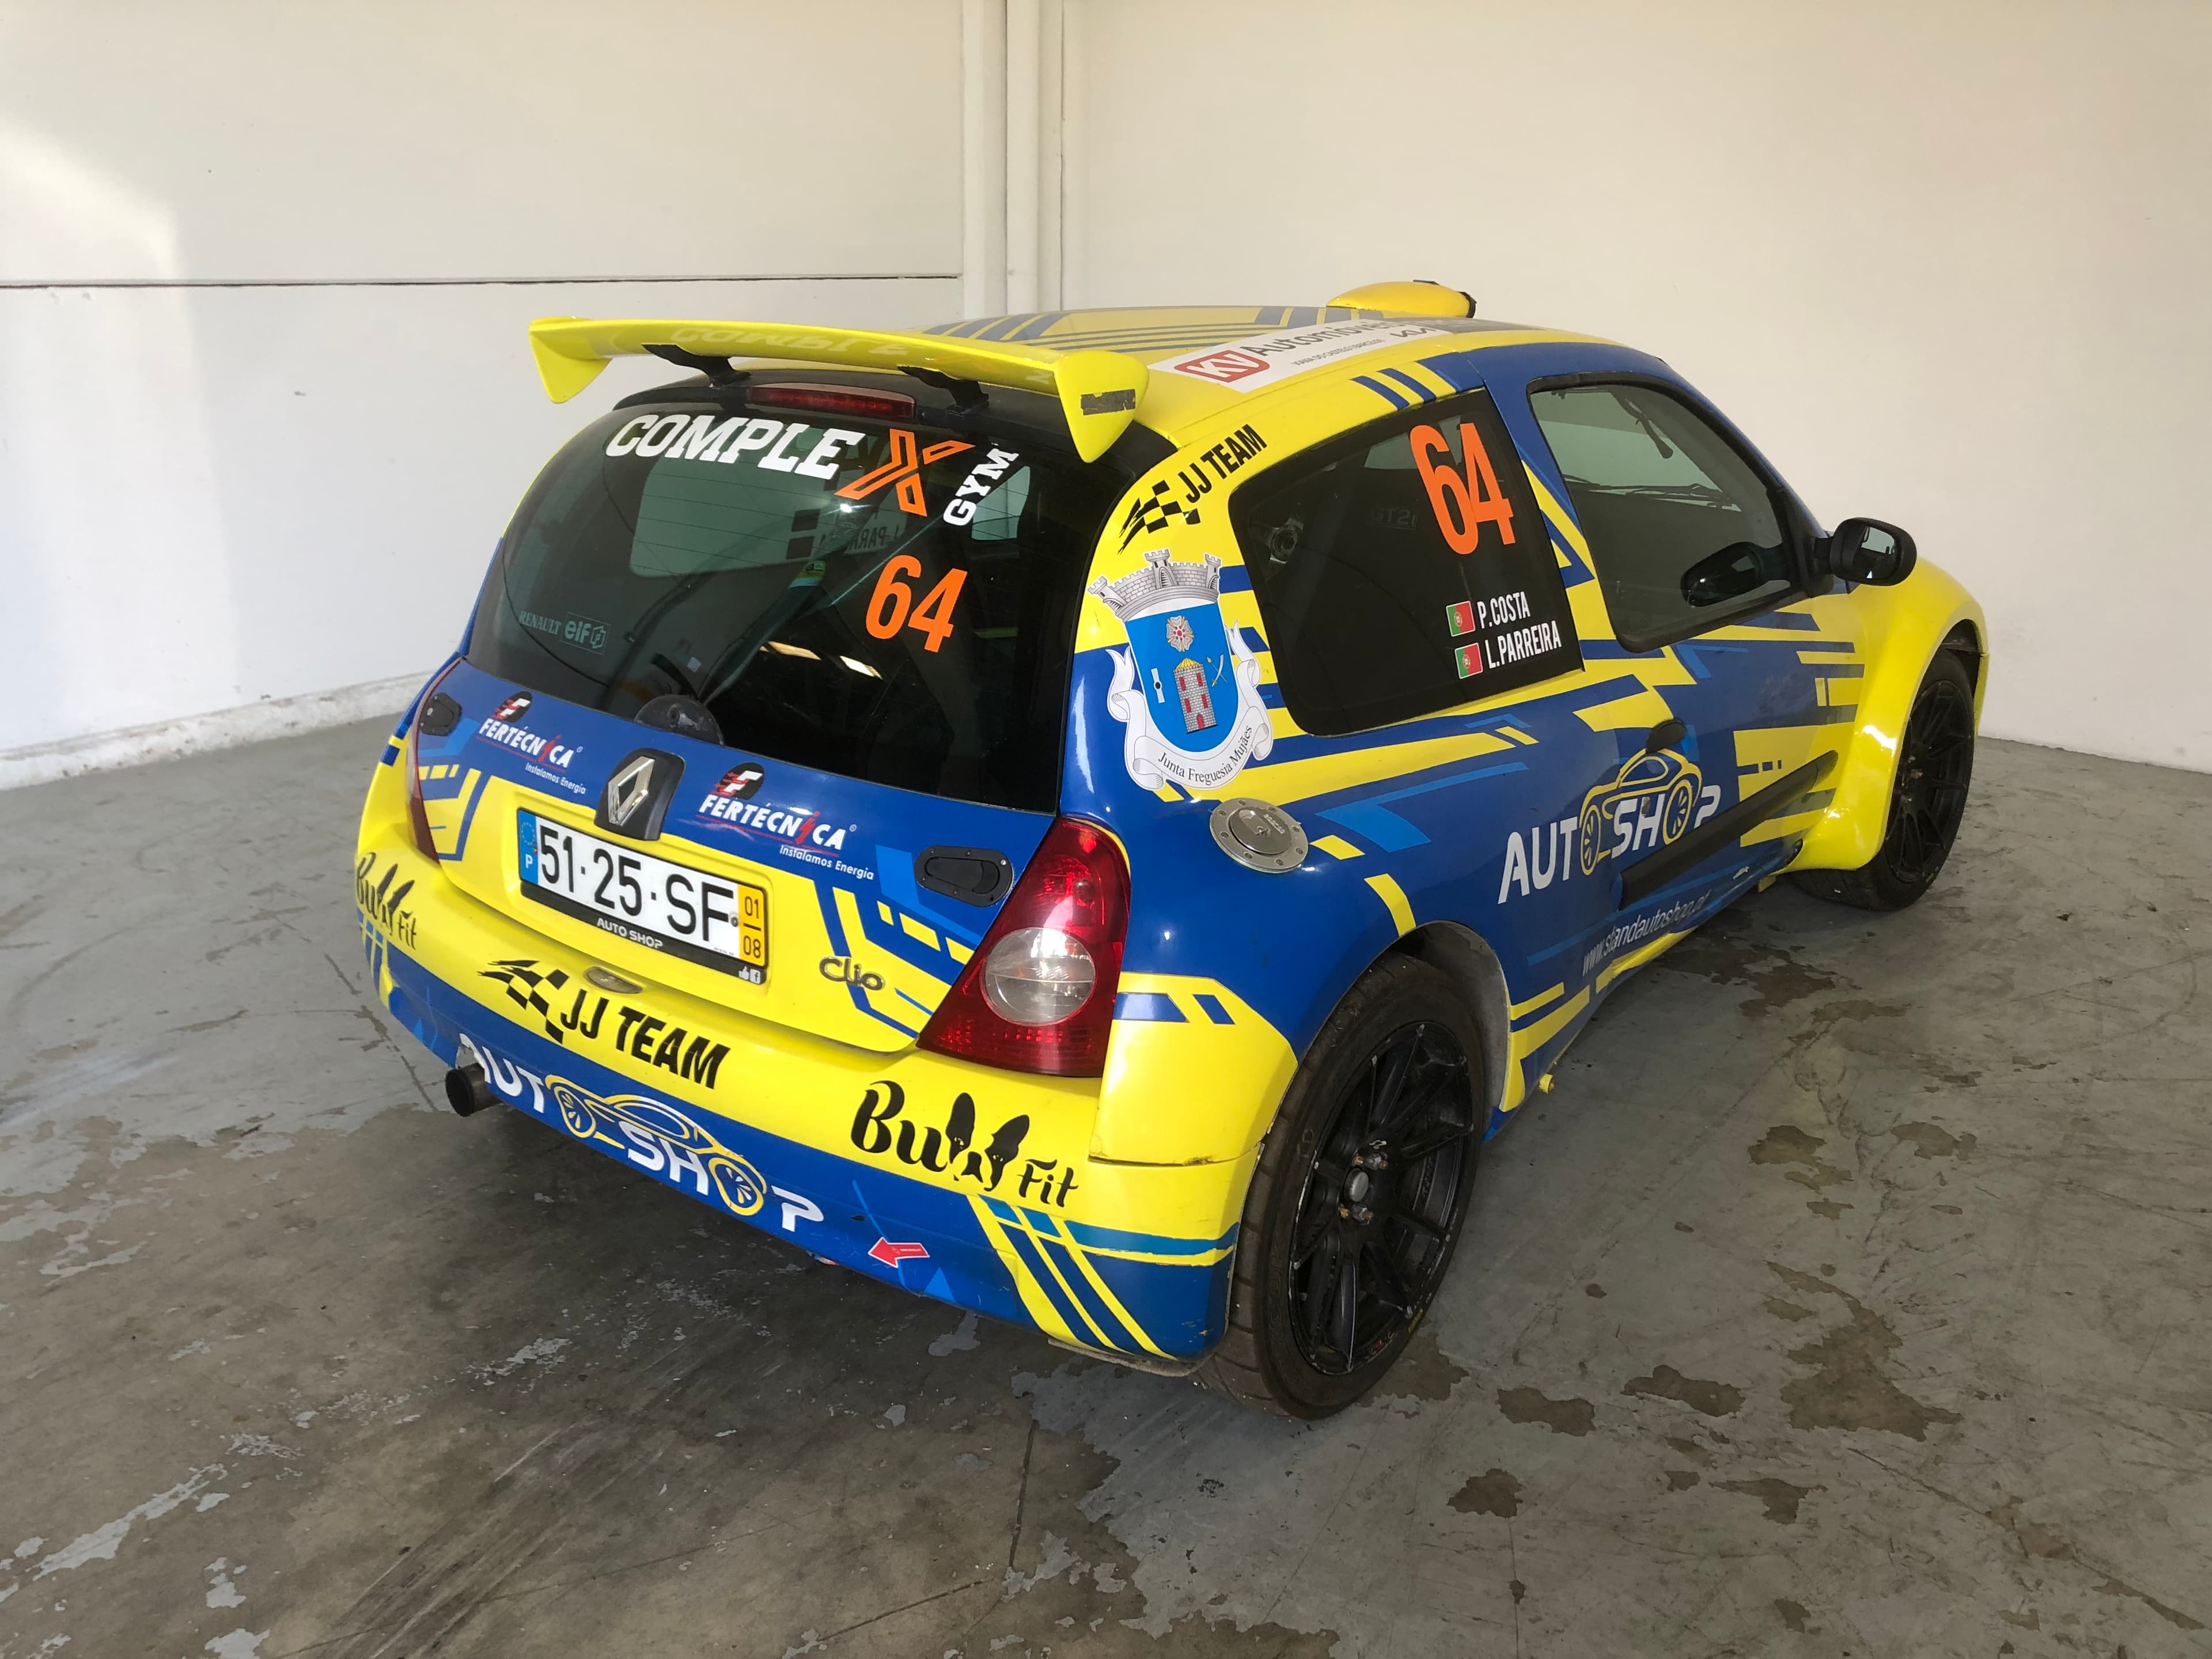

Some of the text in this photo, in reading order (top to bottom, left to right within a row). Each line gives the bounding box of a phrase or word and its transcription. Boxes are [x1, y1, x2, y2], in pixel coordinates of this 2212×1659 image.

[1178, 424, 1267, 503] JJ TEAM
[942, 448, 1019, 527] GYM
[1410, 423, 1516, 555] 64
[865, 555, 968, 653] 64
[519, 611, 592, 643] RENAULT elf
[1158, 725, 1252, 786] Junta Freguesia Mujães
[525, 762, 586, 794] Instalamos Energia
[525, 853, 533, 869] P
[779, 844, 874, 880] Instalamos Energia
[744, 896, 760, 919] 01
[597, 917, 663, 949] AUTO SHOP
[743, 934, 762, 959] 08
[819, 956, 886, 991] Clio
[560, 988, 732, 1090] JJ TEAM
[1017, 1158, 1079, 1208] Fit
